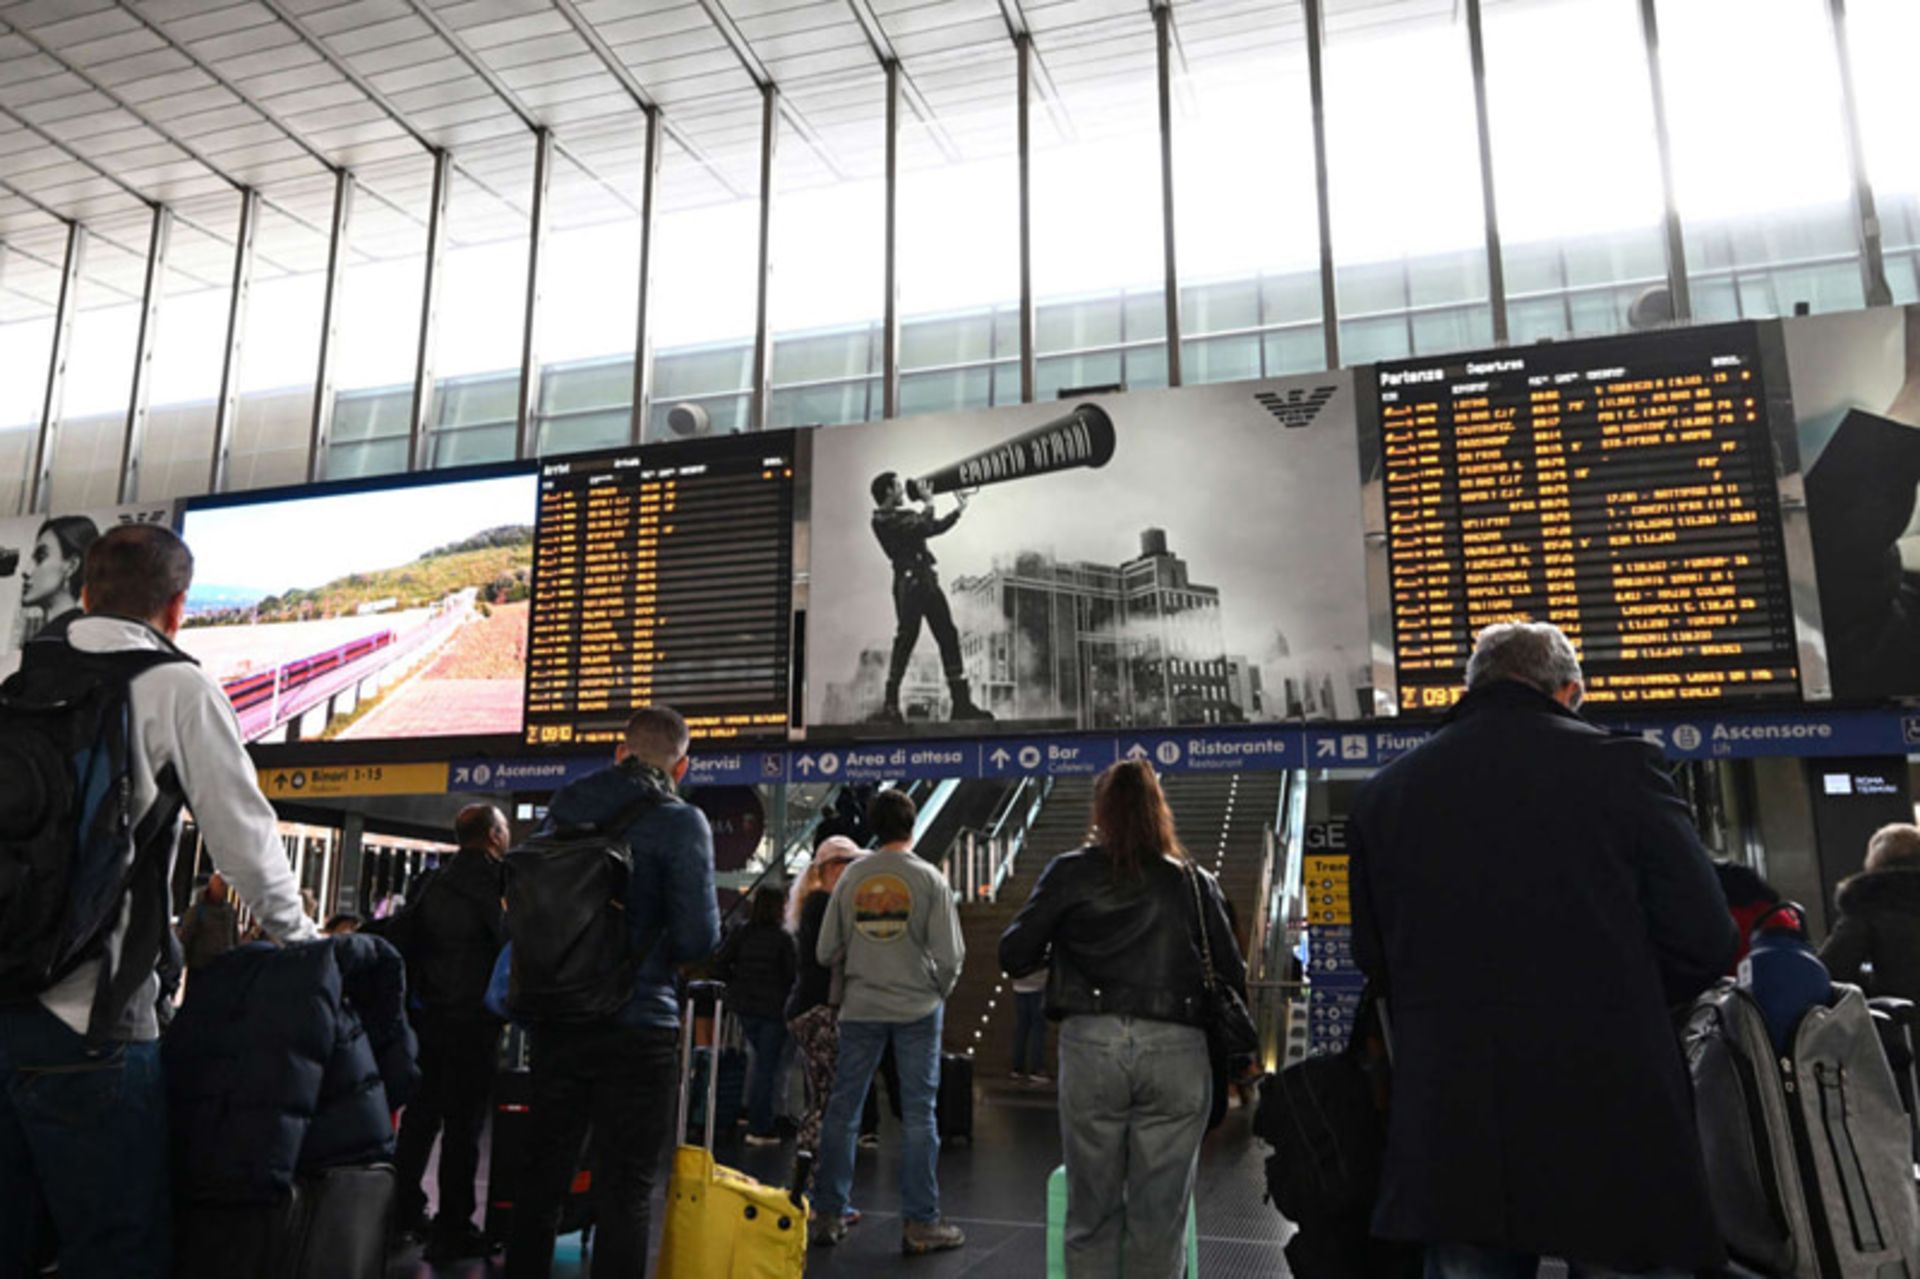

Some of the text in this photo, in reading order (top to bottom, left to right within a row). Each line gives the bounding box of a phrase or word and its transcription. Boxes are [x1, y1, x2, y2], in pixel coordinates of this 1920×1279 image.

[1032, 415, 1092, 469] armani
[1711, 724, 1832, 740] Ascensore
[1048, 745, 1079, 760] Bar
[1188, 739, 1285, 755] Ristorante
[690, 755, 741, 771] Servizi
[846, 750, 963, 766] Area di attesa
[311, 768, 348, 783] Binari
[496, 763, 566, 777] Ascensore
[1314, 860, 1349, 873] Tren
